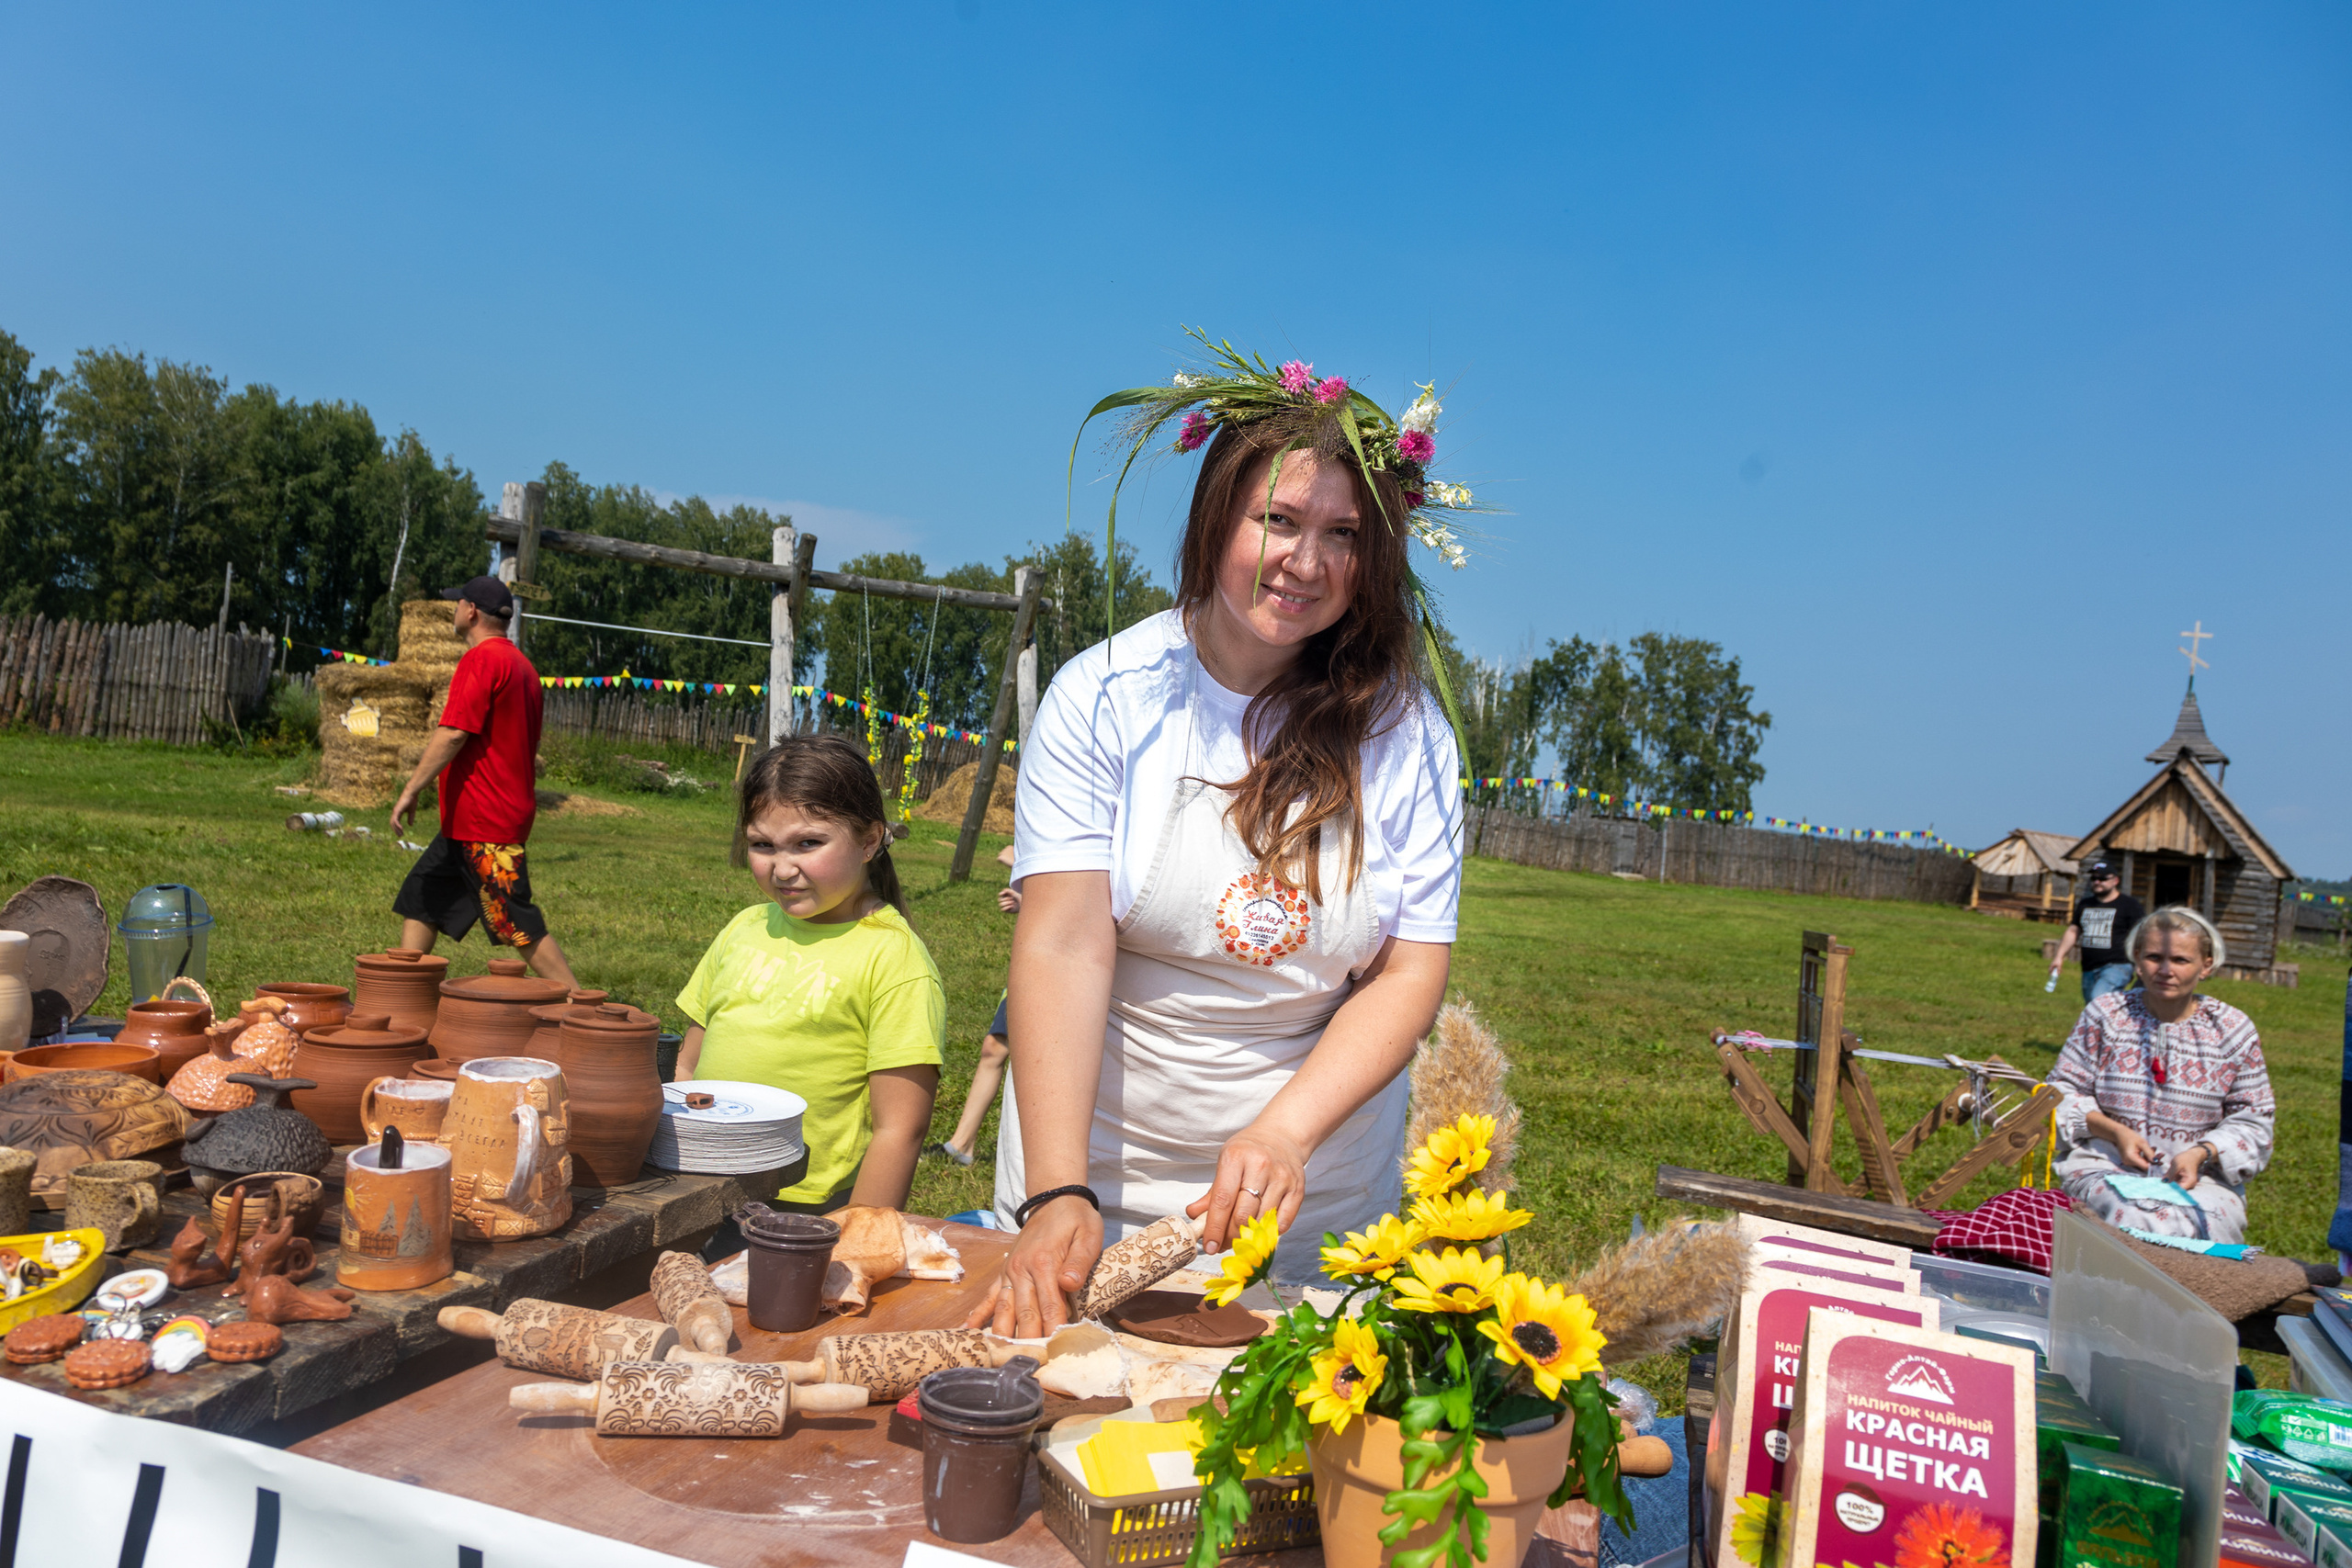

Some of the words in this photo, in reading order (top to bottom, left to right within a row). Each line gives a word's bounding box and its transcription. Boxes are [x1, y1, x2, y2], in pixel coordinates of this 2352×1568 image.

[1242, 919, 1279, 934] Глина
[1243, 910, 1284, 926] Живая
[1848, 1394, 1921, 1419] НАПИТОК
[1924, 1408, 1994, 1435] ЧАЙНЫЙ
[1847, 1409, 1990, 1461] КРАСНАЯ
[1845, 1439, 1989, 1499] ЩЕТКА
[1847, 1501, 1874, 1514] 100%
